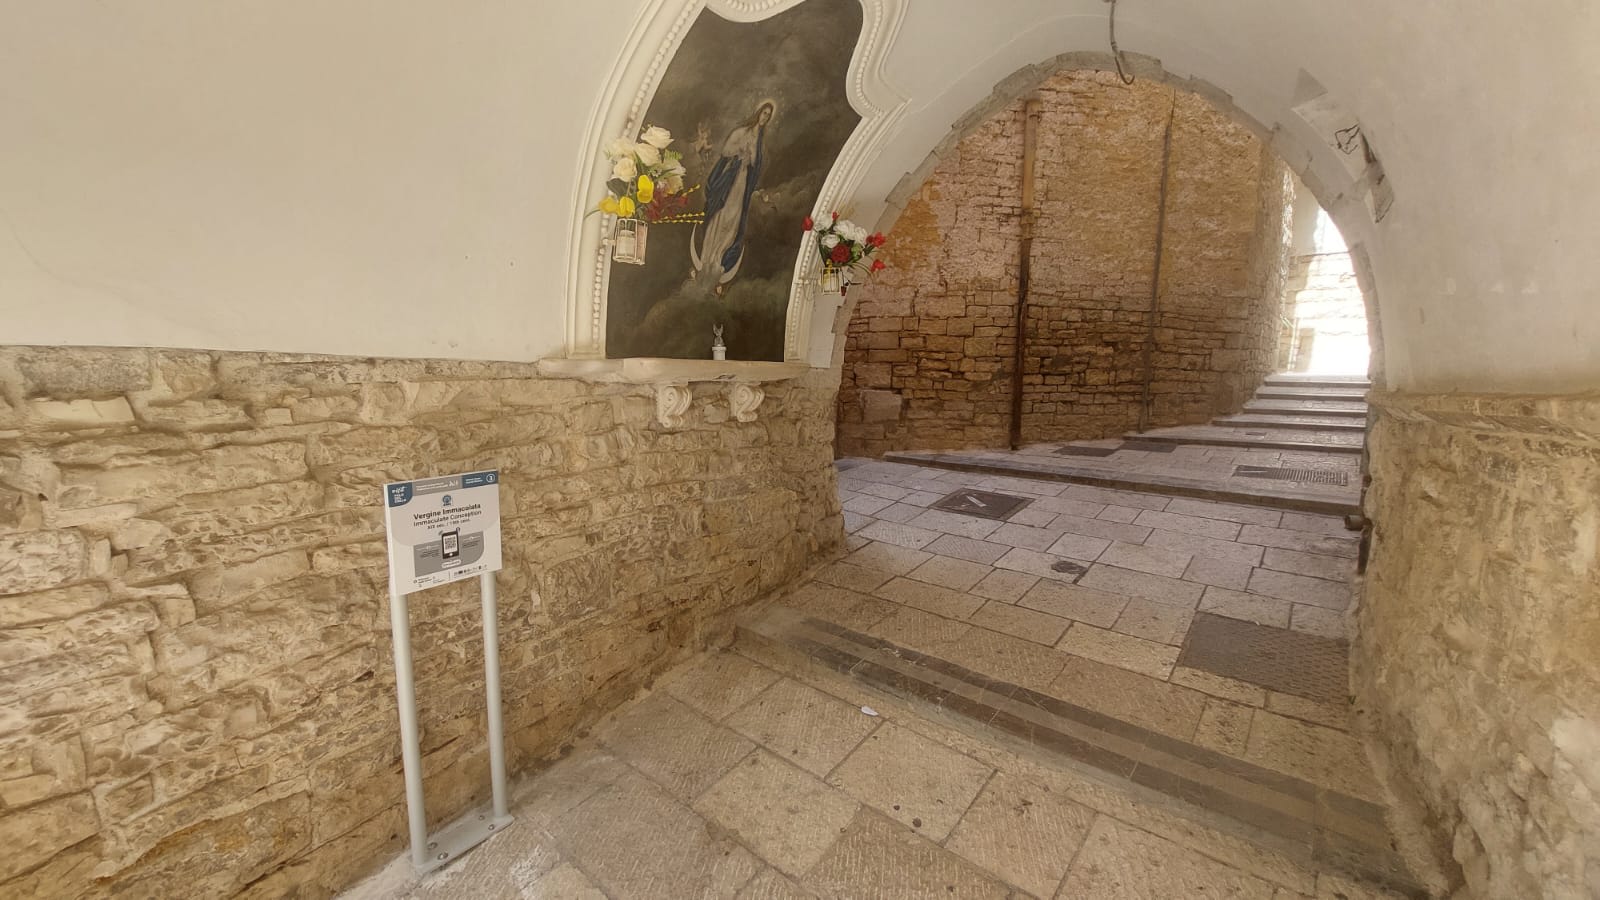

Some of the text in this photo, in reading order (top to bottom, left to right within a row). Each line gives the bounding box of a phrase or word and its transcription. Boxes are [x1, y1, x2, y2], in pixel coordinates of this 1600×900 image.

[413, 511, 441, 519] Vergine
[413, 510, 482, 527] Immaculate Conception
